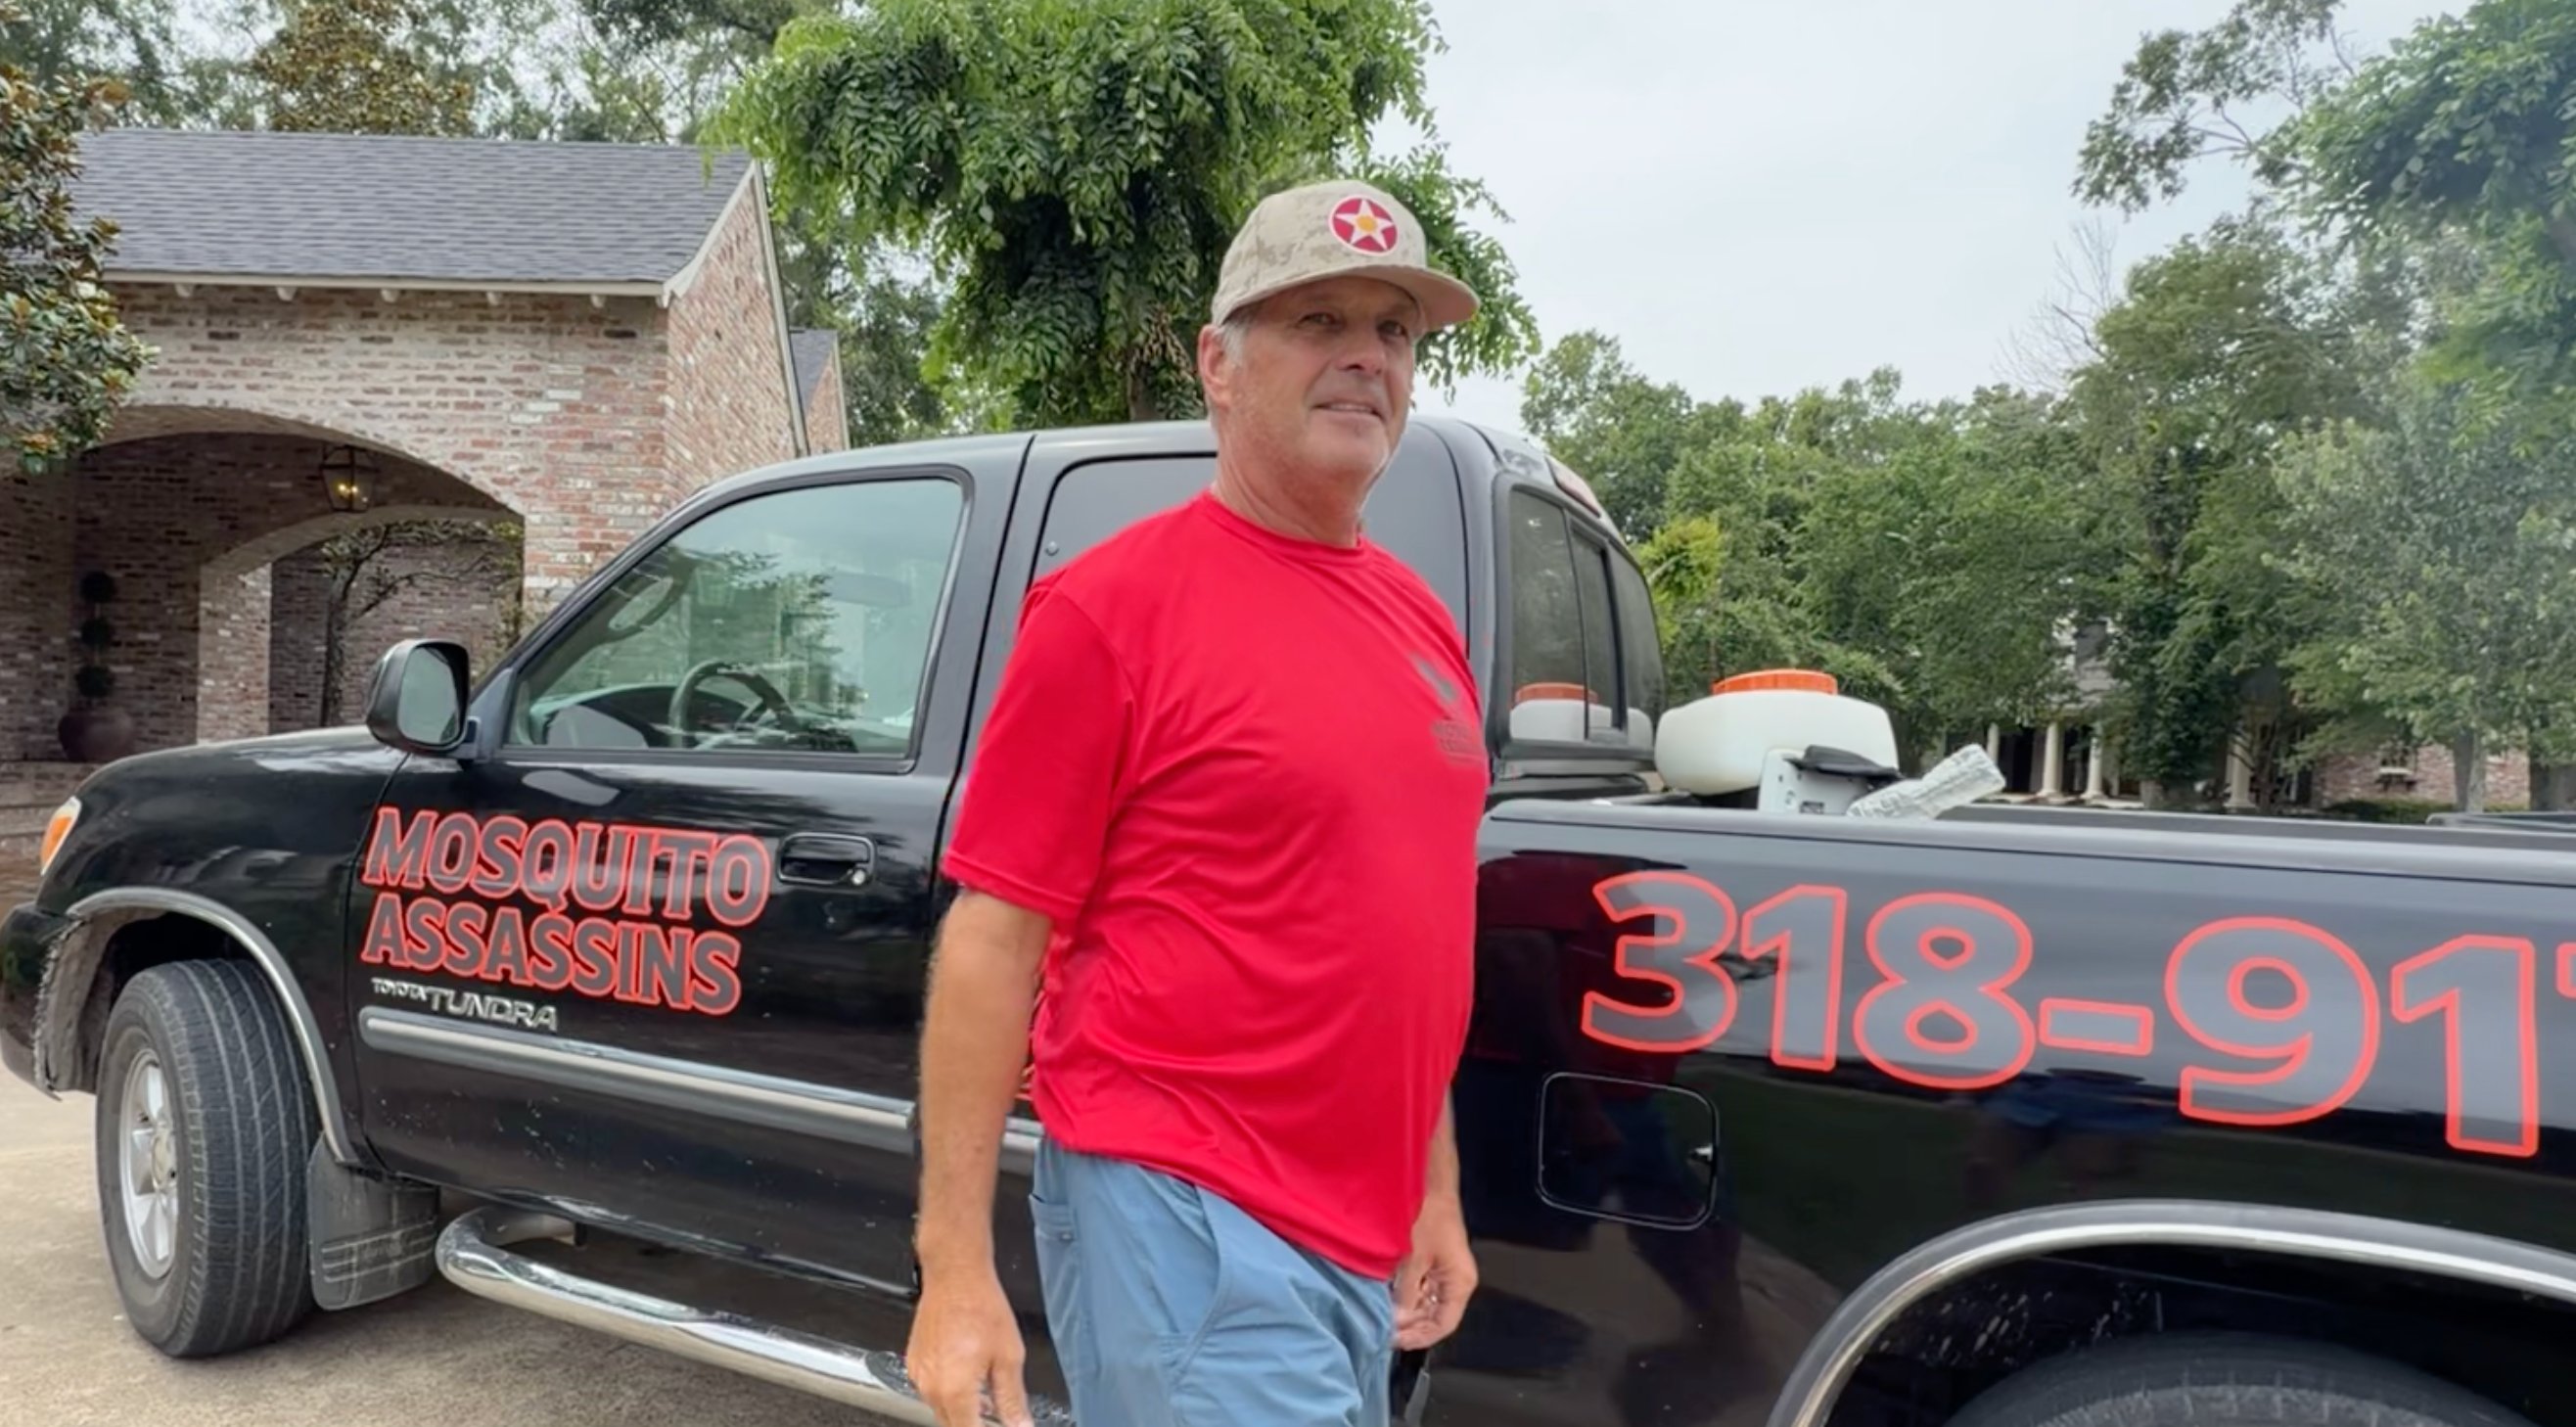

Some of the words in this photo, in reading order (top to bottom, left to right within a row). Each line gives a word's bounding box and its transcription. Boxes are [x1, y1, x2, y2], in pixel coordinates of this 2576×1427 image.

[361, 807, 771, 928] MOSQUITO
[360, 892, 742, 1016] ASSASSINS
[371, 977, 427, 1001] TOYOTA
[425, 985, 558, 1032] TUNDRA
[1581, 870, 2576, 1157] 318-91
